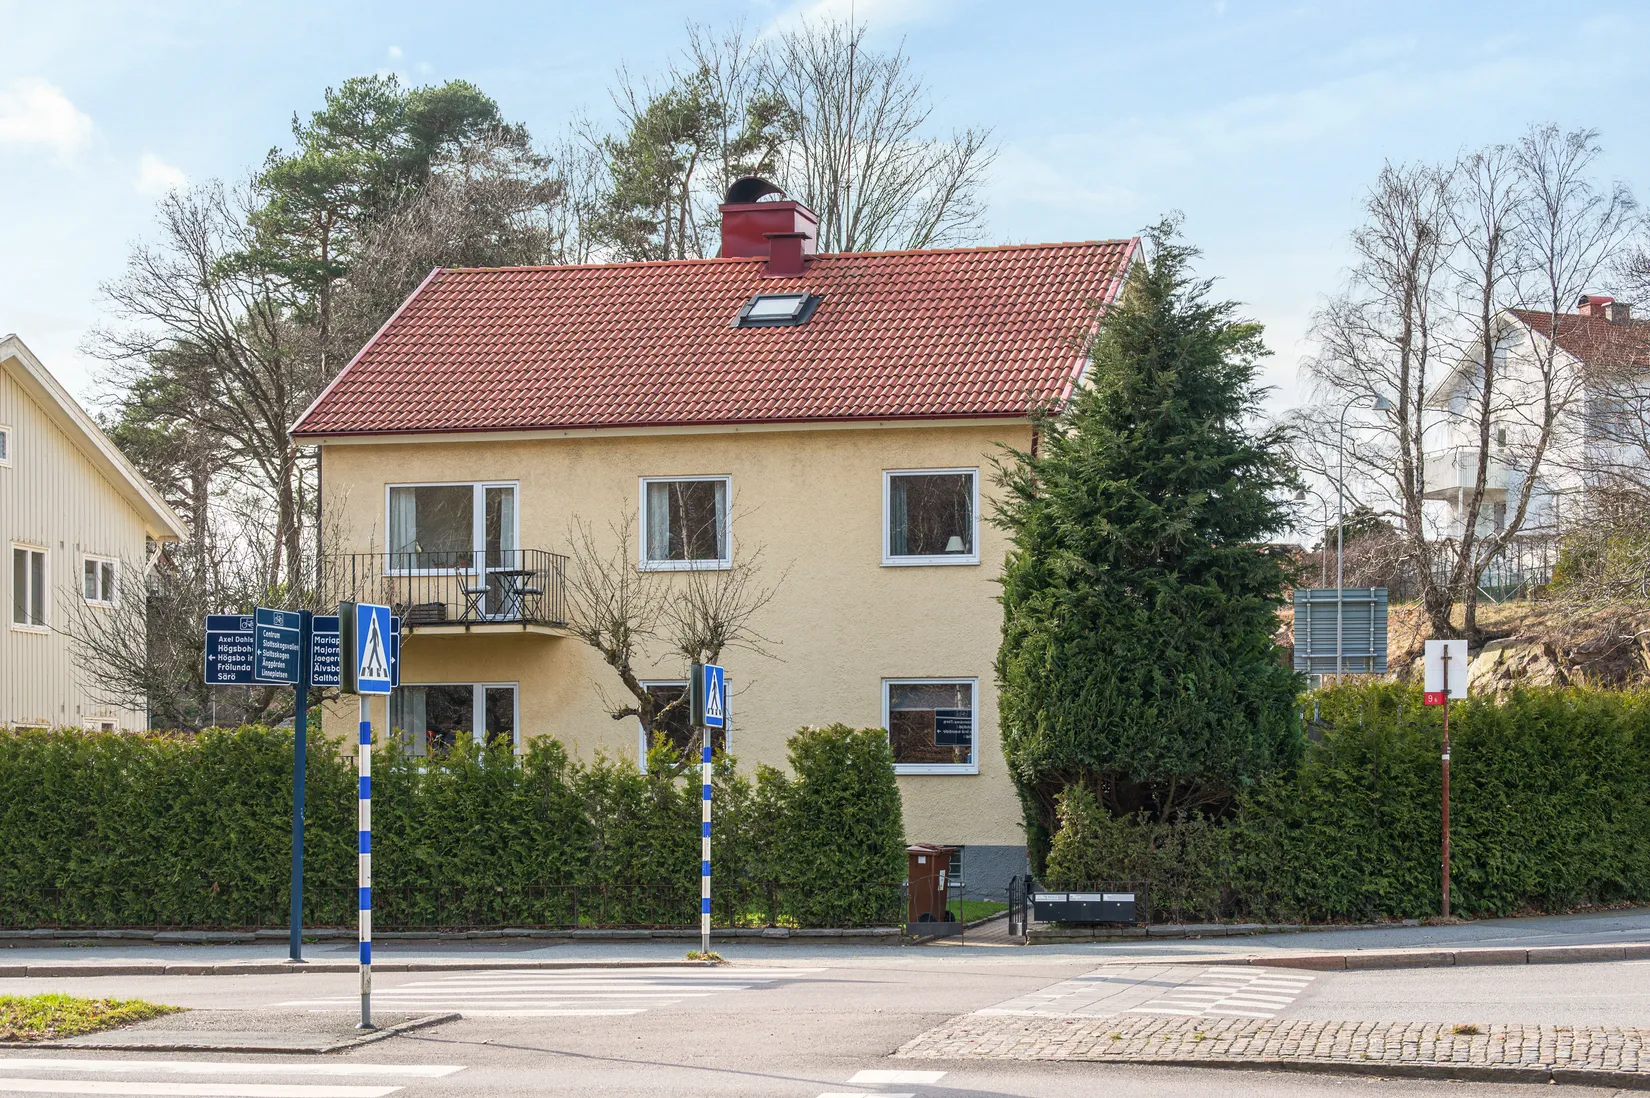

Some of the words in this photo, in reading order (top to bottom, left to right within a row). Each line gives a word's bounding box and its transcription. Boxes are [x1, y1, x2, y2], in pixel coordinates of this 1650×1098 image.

[263, 630, 280, 638] Centrum
[218, 654, 246, 663] Högsbo
[262, 649, 289, 660] Slottsskogen
